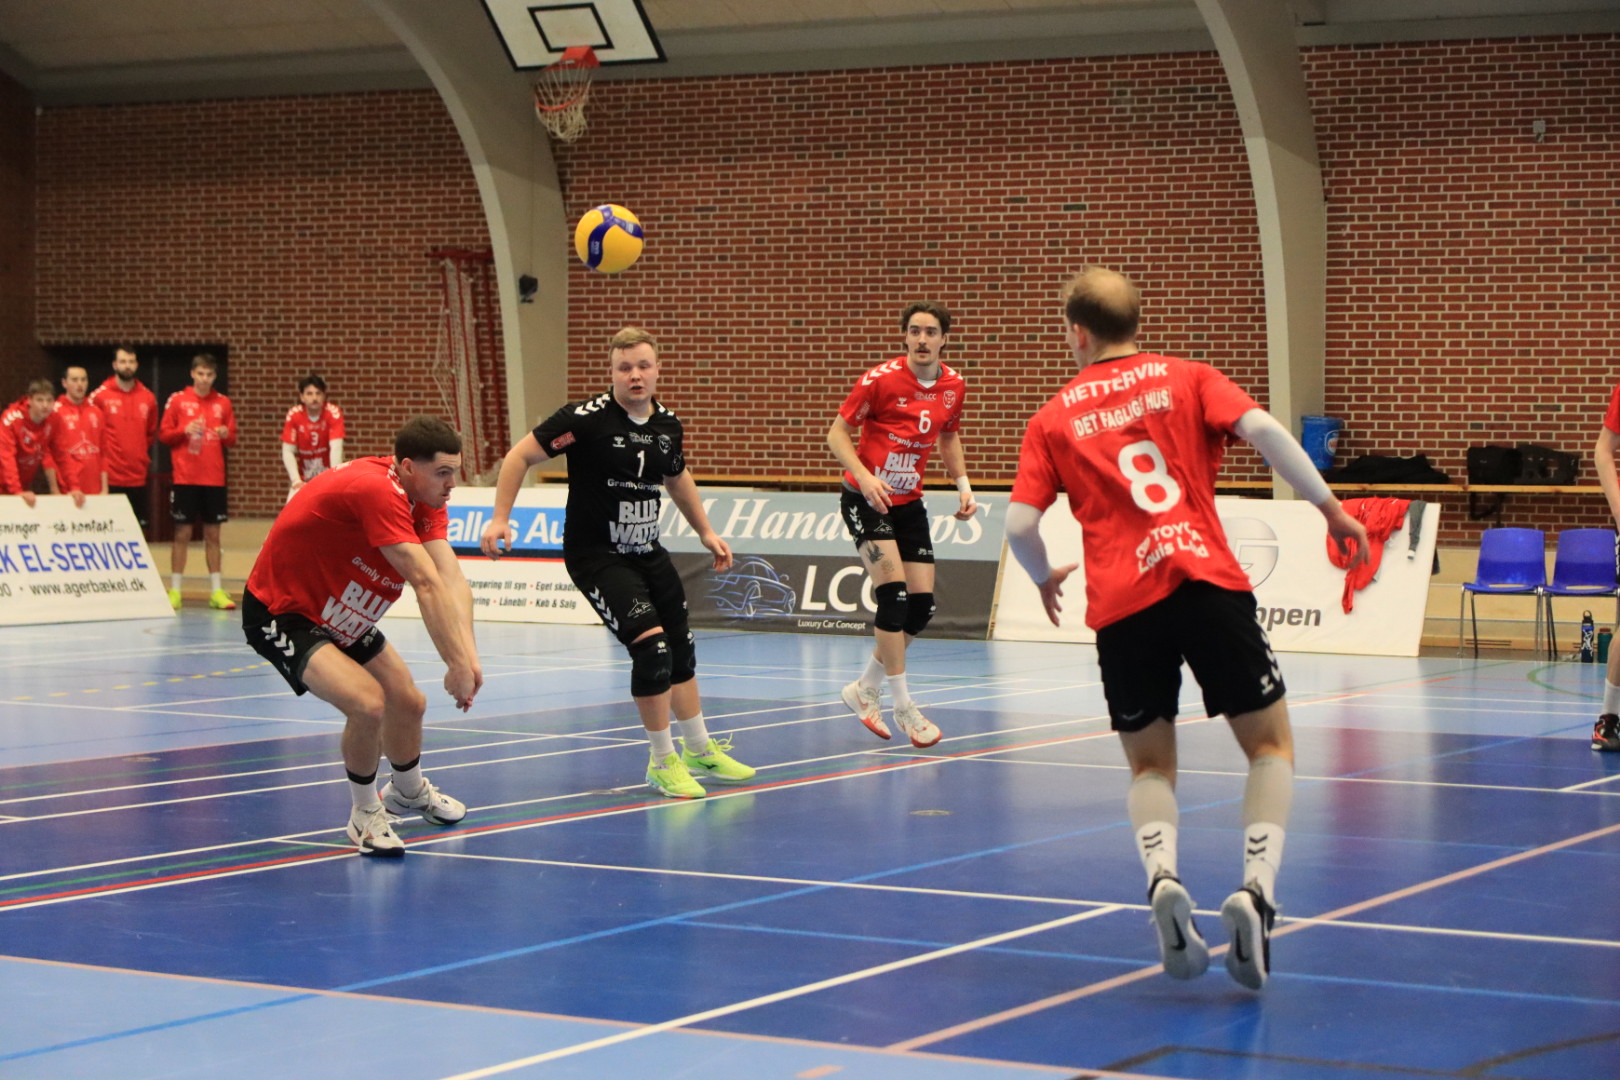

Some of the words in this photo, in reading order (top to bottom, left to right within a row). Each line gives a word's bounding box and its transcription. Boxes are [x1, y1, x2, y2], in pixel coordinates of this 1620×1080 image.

[1061, 362, 1168, 408] HETTERVIK
[918, 409, 931, 434] 6
[1073, 413, 1098, 437] DET
[1145, 389, 1170, 410] HUS
[310, 431, 319, 446] 3
[637, 450, 645, 478] 1
[884, 451, 921, 472] BLUE
[1118, 440, 1181, 513] 8
[619, 499, 658, 523] BLUE
[0, 522, 40, 539] ninger
[523, 512, 564, 544] Au
[18, 542, 149, 573] EL-SERVICE
[1138, 542, 1175, 574] Louis
[29, 577, 147, 598] www.agerbækel.dk
[352, 556, 380, 582] Granly
[381, 576, 405, 592] Grup
[468, 579, 502, 591] largøring
[514, 582, 527, 591] syn
[536, 581, 553, 592] Eget
[341, 580, 393, 621] BLU
[536, 599, 550, 608] Køb
[560, 600, 577, 610] Salg
[321, 595, 375, 639] WAT
[798, 619, 820, 630] Luxury
[823, 620, 835, 628] Car
[836, 621, 866, 631] Concept
